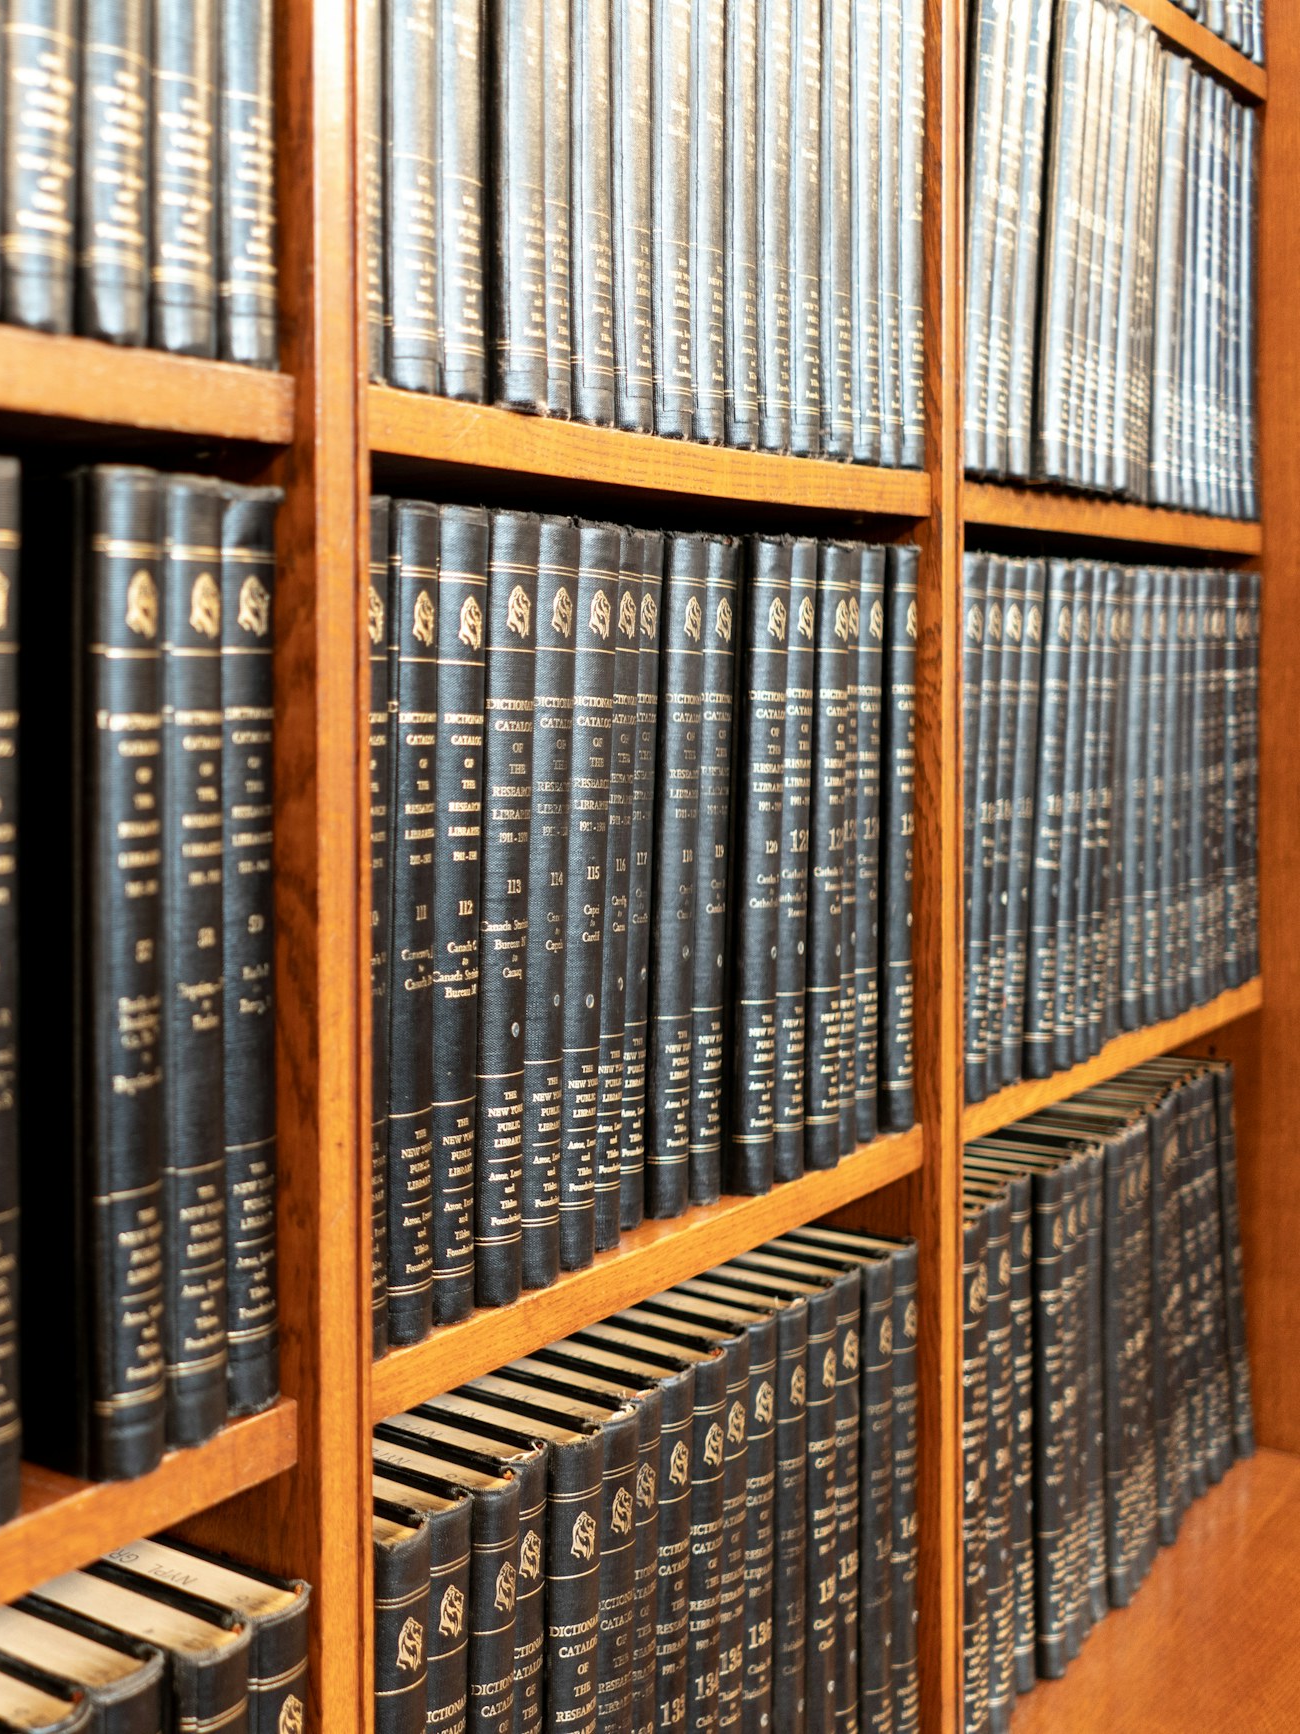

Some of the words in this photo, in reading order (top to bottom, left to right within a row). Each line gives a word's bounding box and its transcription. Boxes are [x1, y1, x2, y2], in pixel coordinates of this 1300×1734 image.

[512, 743, 524, 753] OF
[556, 739, 567, 750] OF
[592, 737, 604, 748] OF
[464, 758, 474, 769] OF
[589, 756, 605, 768] THE
[509, 764, 526, 775] THE
[461, 779, 476, 790] THE
[715, 844, 725, 859] 119
[765, 840, 778, 854] 120
[636, 852, 648, 866] 117
[682, 849, 693, 863] 118
[615, 858, 626, 872] 116
[550, 872, 564, 886] 114
[587, 865, 600, 881] 115
[507, 878, 522, 894] 113
[416, 904, 427, 921] 111
[458, 900, 473, 916] 112
[481, 920, 512, 932] Canada
[494, 938, 520, 950] Bureau
[433, 970, 463, 983] Canada
[444, 987, 471, 999] Bureau
[581, 1065, 594, 1073] THE
[598, 1065, 615, 1074] NEW
[547, 1076, 559, 1085] THE
[568, 1080, 587, 1089] NEW
[504, 1090, 517, 1100] THE
[532, 1093, 550, 1103] NEW
[575, 1093, 596, 1103] PUBLIC
[488, 1107, 510, 1118] NEW
[457, 1117, 469, 1128] THE
[497, 1120, 520, 1132] PUBLIC
[442, 1134, 462, 1146] NEW
[494, 1135, 522, 1148] LIBRARY
[401, 1147, 421, 1159] NEW
[451, 1147, 472, 1161] PUBLIC
[410, 1159, 430, 1174] PUBLIC
[504, 1183, 515, 1194] and
[458, 1213, 468, 1224] and
[148, 1563, 199, 1586] NYPL
[577, 1662, 589, 1675] OF
[525, 1683, 536, 1697] OF
[573, 1681, 591, 1697] THE
[522, 1703, 538, 1721] THE
[498, 1720, 509, 1733] OF
